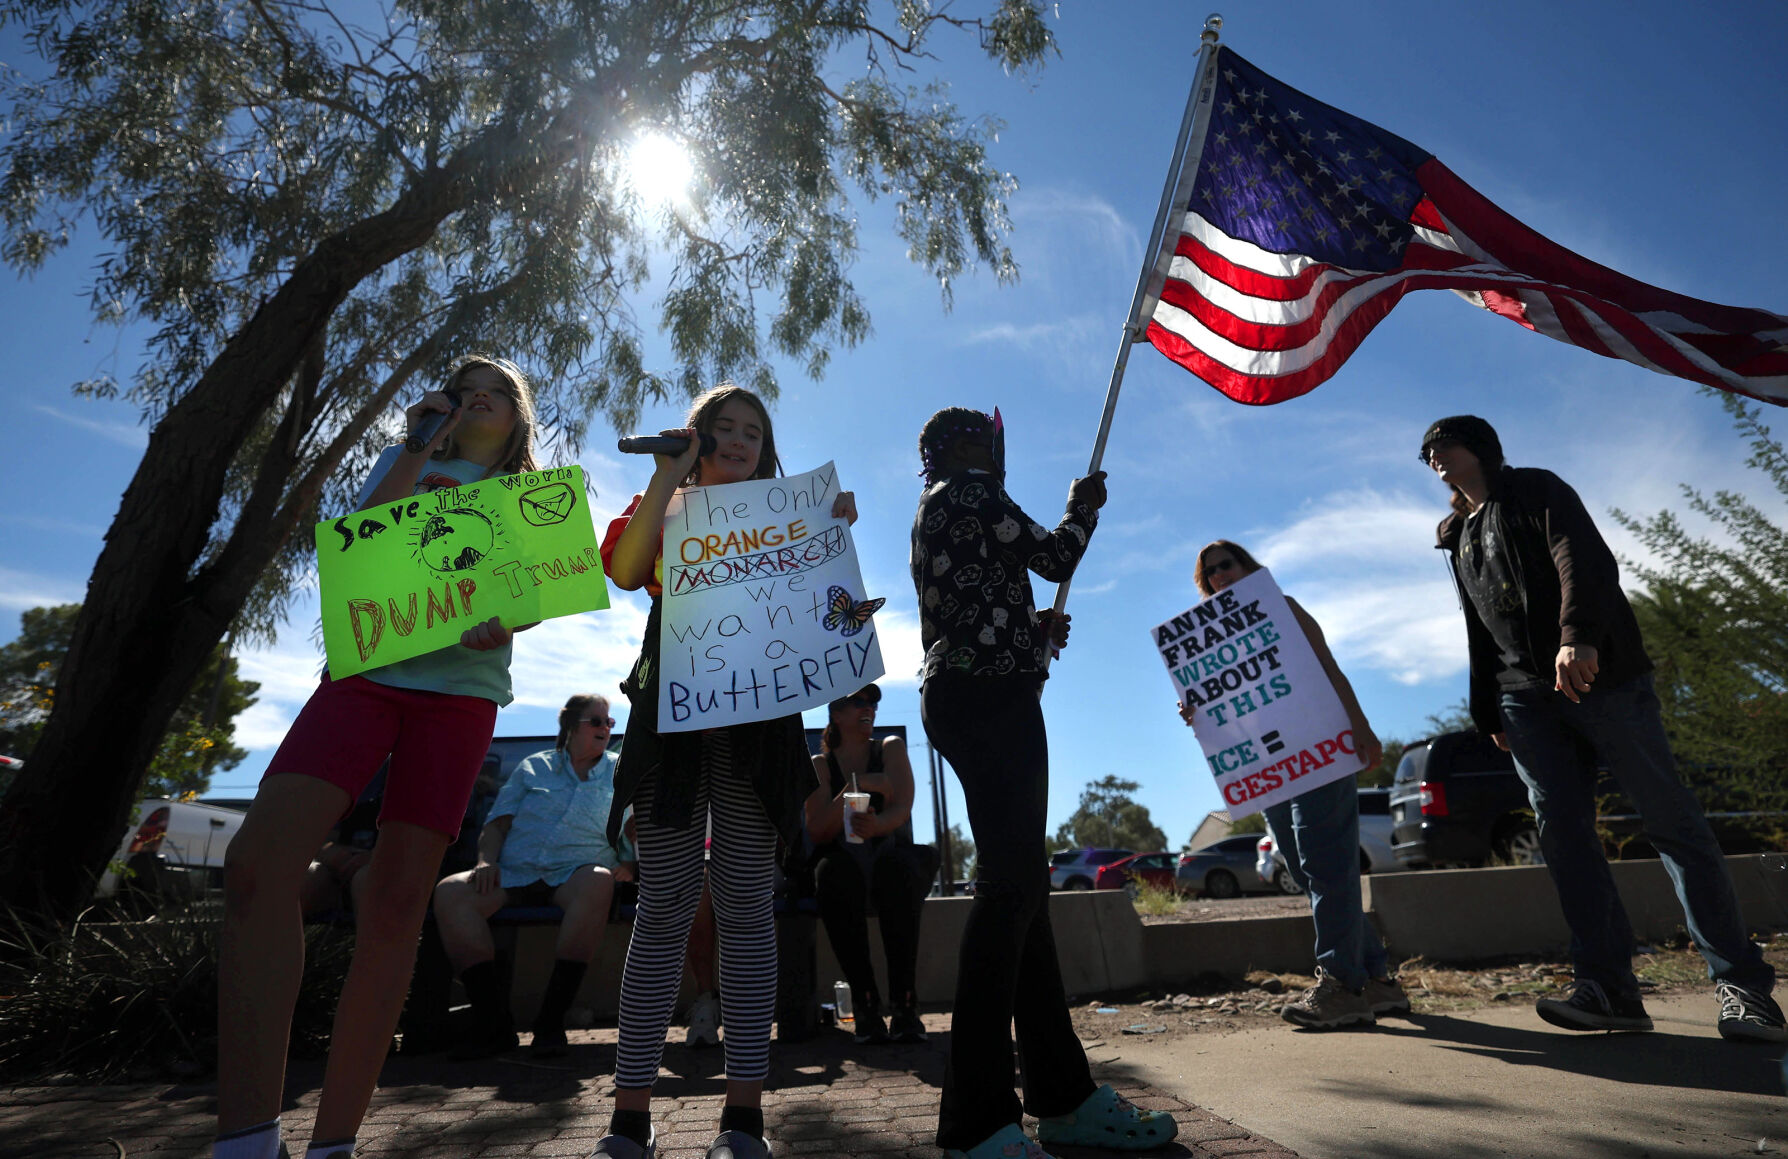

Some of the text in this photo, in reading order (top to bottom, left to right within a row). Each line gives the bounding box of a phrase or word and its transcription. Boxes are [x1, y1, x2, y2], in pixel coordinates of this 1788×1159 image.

[333, 501, 419, 552] Save
[674, 467, 836, 532] The Only
[674, 526, 843, 592] MONARCH
[680, 519, 808, 565] ORANGE
[744, 574, 807, 603] we
[347, 578, 476, 664] DUMP
[669, 591, 826, 644] want
[1157, 589, 1240, 648] ANNE
[1162, 600, 1269, 669] FRANK
[689, 639, 799, 677] is a
[1173, 621, 1281, 688] WROTE
[1185, 646, 1282, 708] ABOUT
[1206, 673, 1292, 727] THIS
[1207, 739, 1260, 777] ICE
